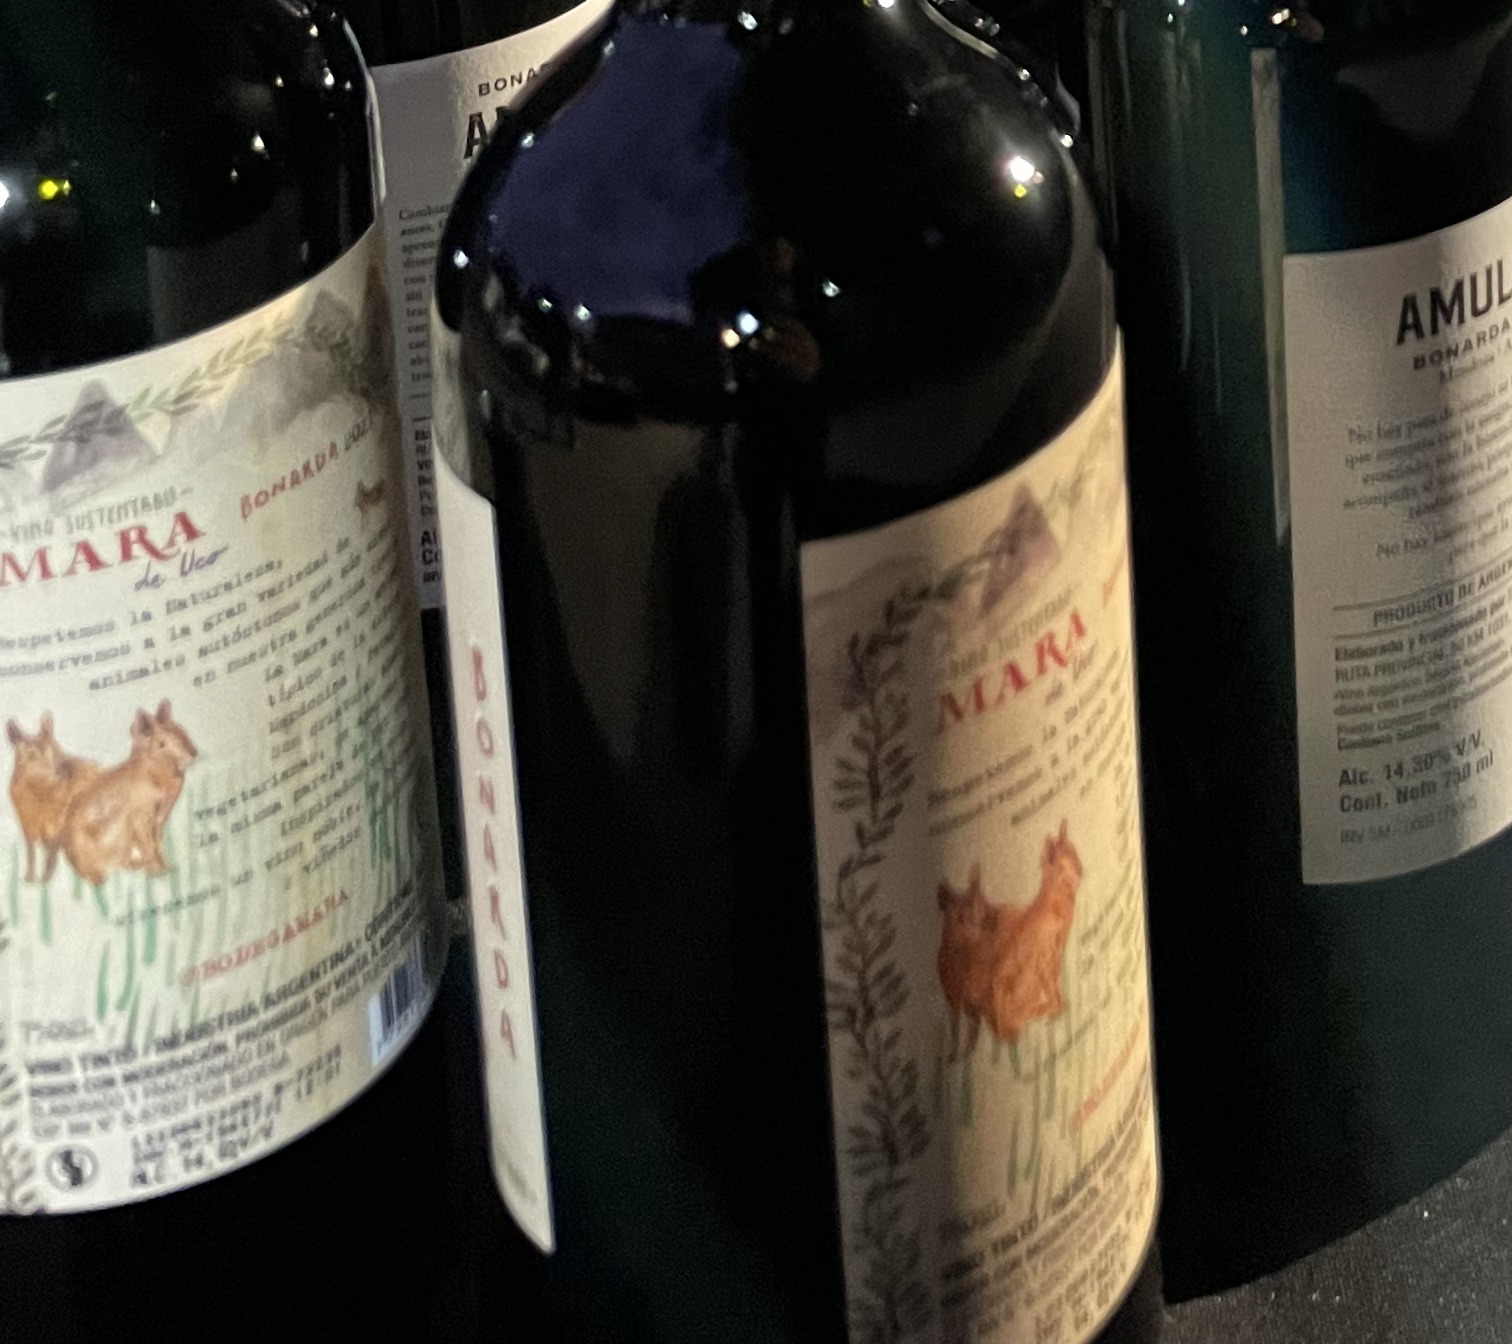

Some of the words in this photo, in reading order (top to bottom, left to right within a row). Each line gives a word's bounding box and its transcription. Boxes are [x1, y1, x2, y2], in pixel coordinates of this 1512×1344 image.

[478, 63, 551, 97] BONA
[1413, 317, 1511, 371] BONARDA
[240, 440, 339, 523] BONARDA
[0, 510, 207, 588] MARA
[134, 562, 165, 592] de
[1373, 590, 1454, 627] PRODUCTO
[936, 607, 1088, 736] MARA
